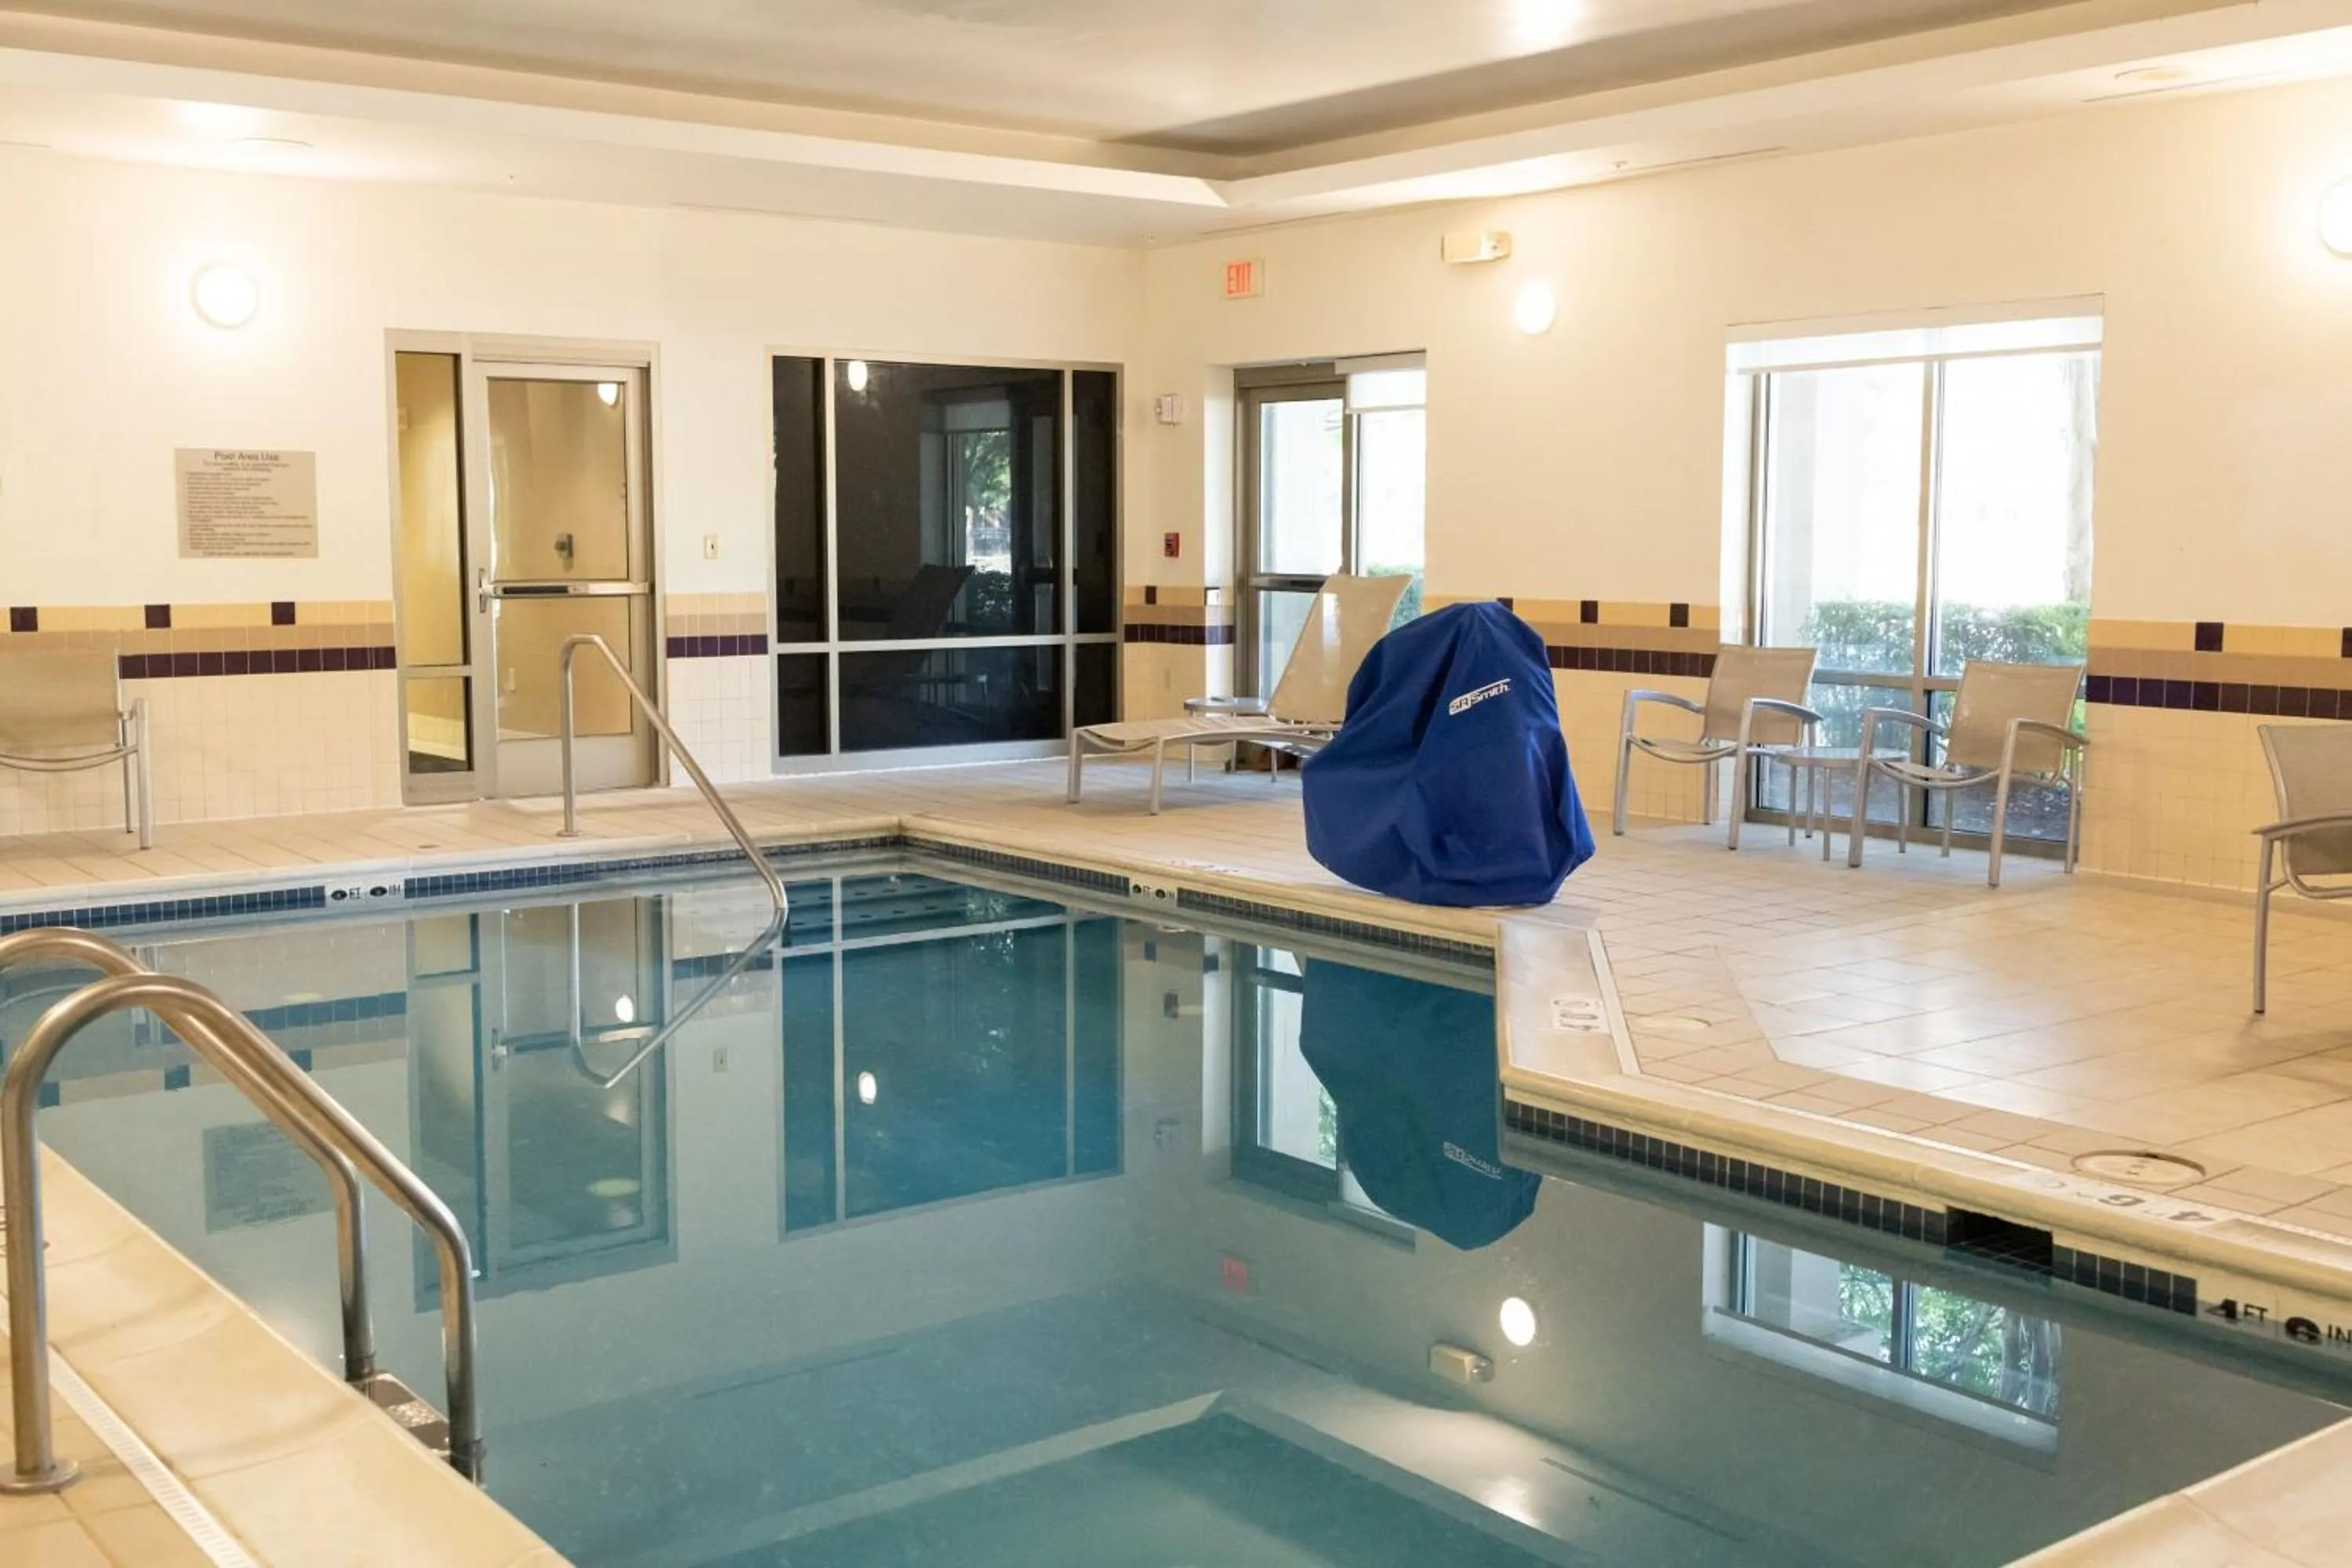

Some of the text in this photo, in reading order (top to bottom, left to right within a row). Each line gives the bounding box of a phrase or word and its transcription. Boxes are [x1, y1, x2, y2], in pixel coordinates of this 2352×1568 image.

[1227, 263, 1254, 295] EXIT
[215, 452, 280, 462] Pool Area Use
[2244, 1303, 2269, 1323] FT
[2327, 1324, 2352, 1344] IN
